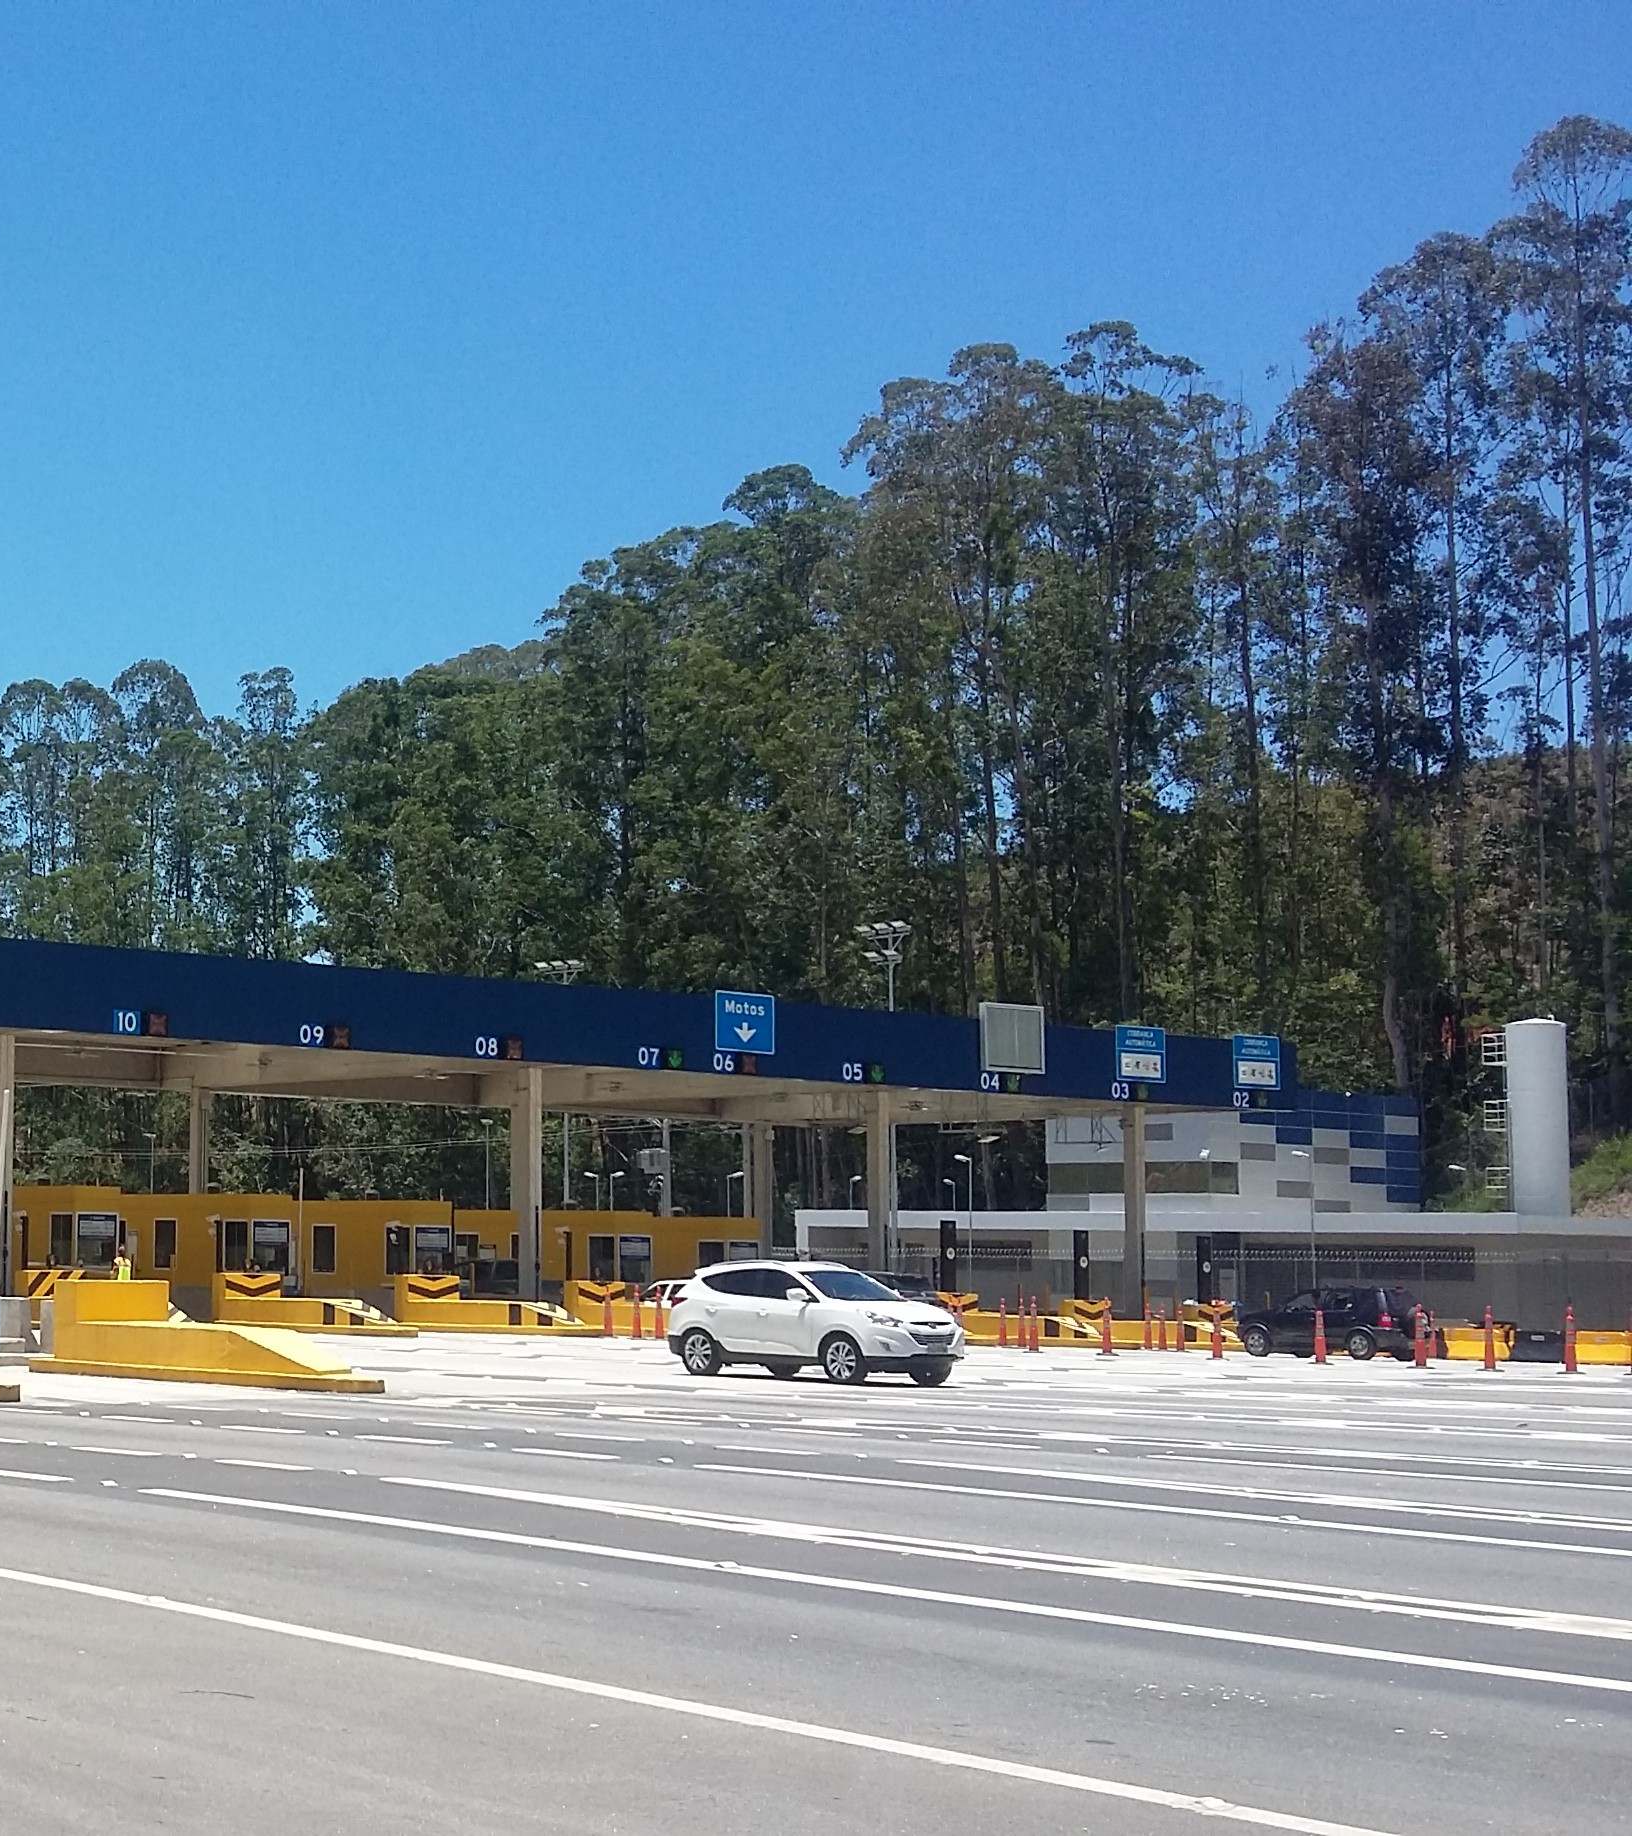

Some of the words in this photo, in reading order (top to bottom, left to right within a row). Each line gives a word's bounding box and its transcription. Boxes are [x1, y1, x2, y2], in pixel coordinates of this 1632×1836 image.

[724, 999, 766, 1017] Motos
[117, 1011, 137, 1032] 10
[299, 1024, 325, 1045] 09
[475, 1036, 498, 1057] 08
[638, 1046, 660, 1066] 07
[713, 1053, 735, 1072] 06
[842, 1062, 863, 1081] 05
[980, 1072, 1000, 1090] 04
[1111, 1081, 1130, 1099] 03
[1232, 1091, 1250, 1108] 02
